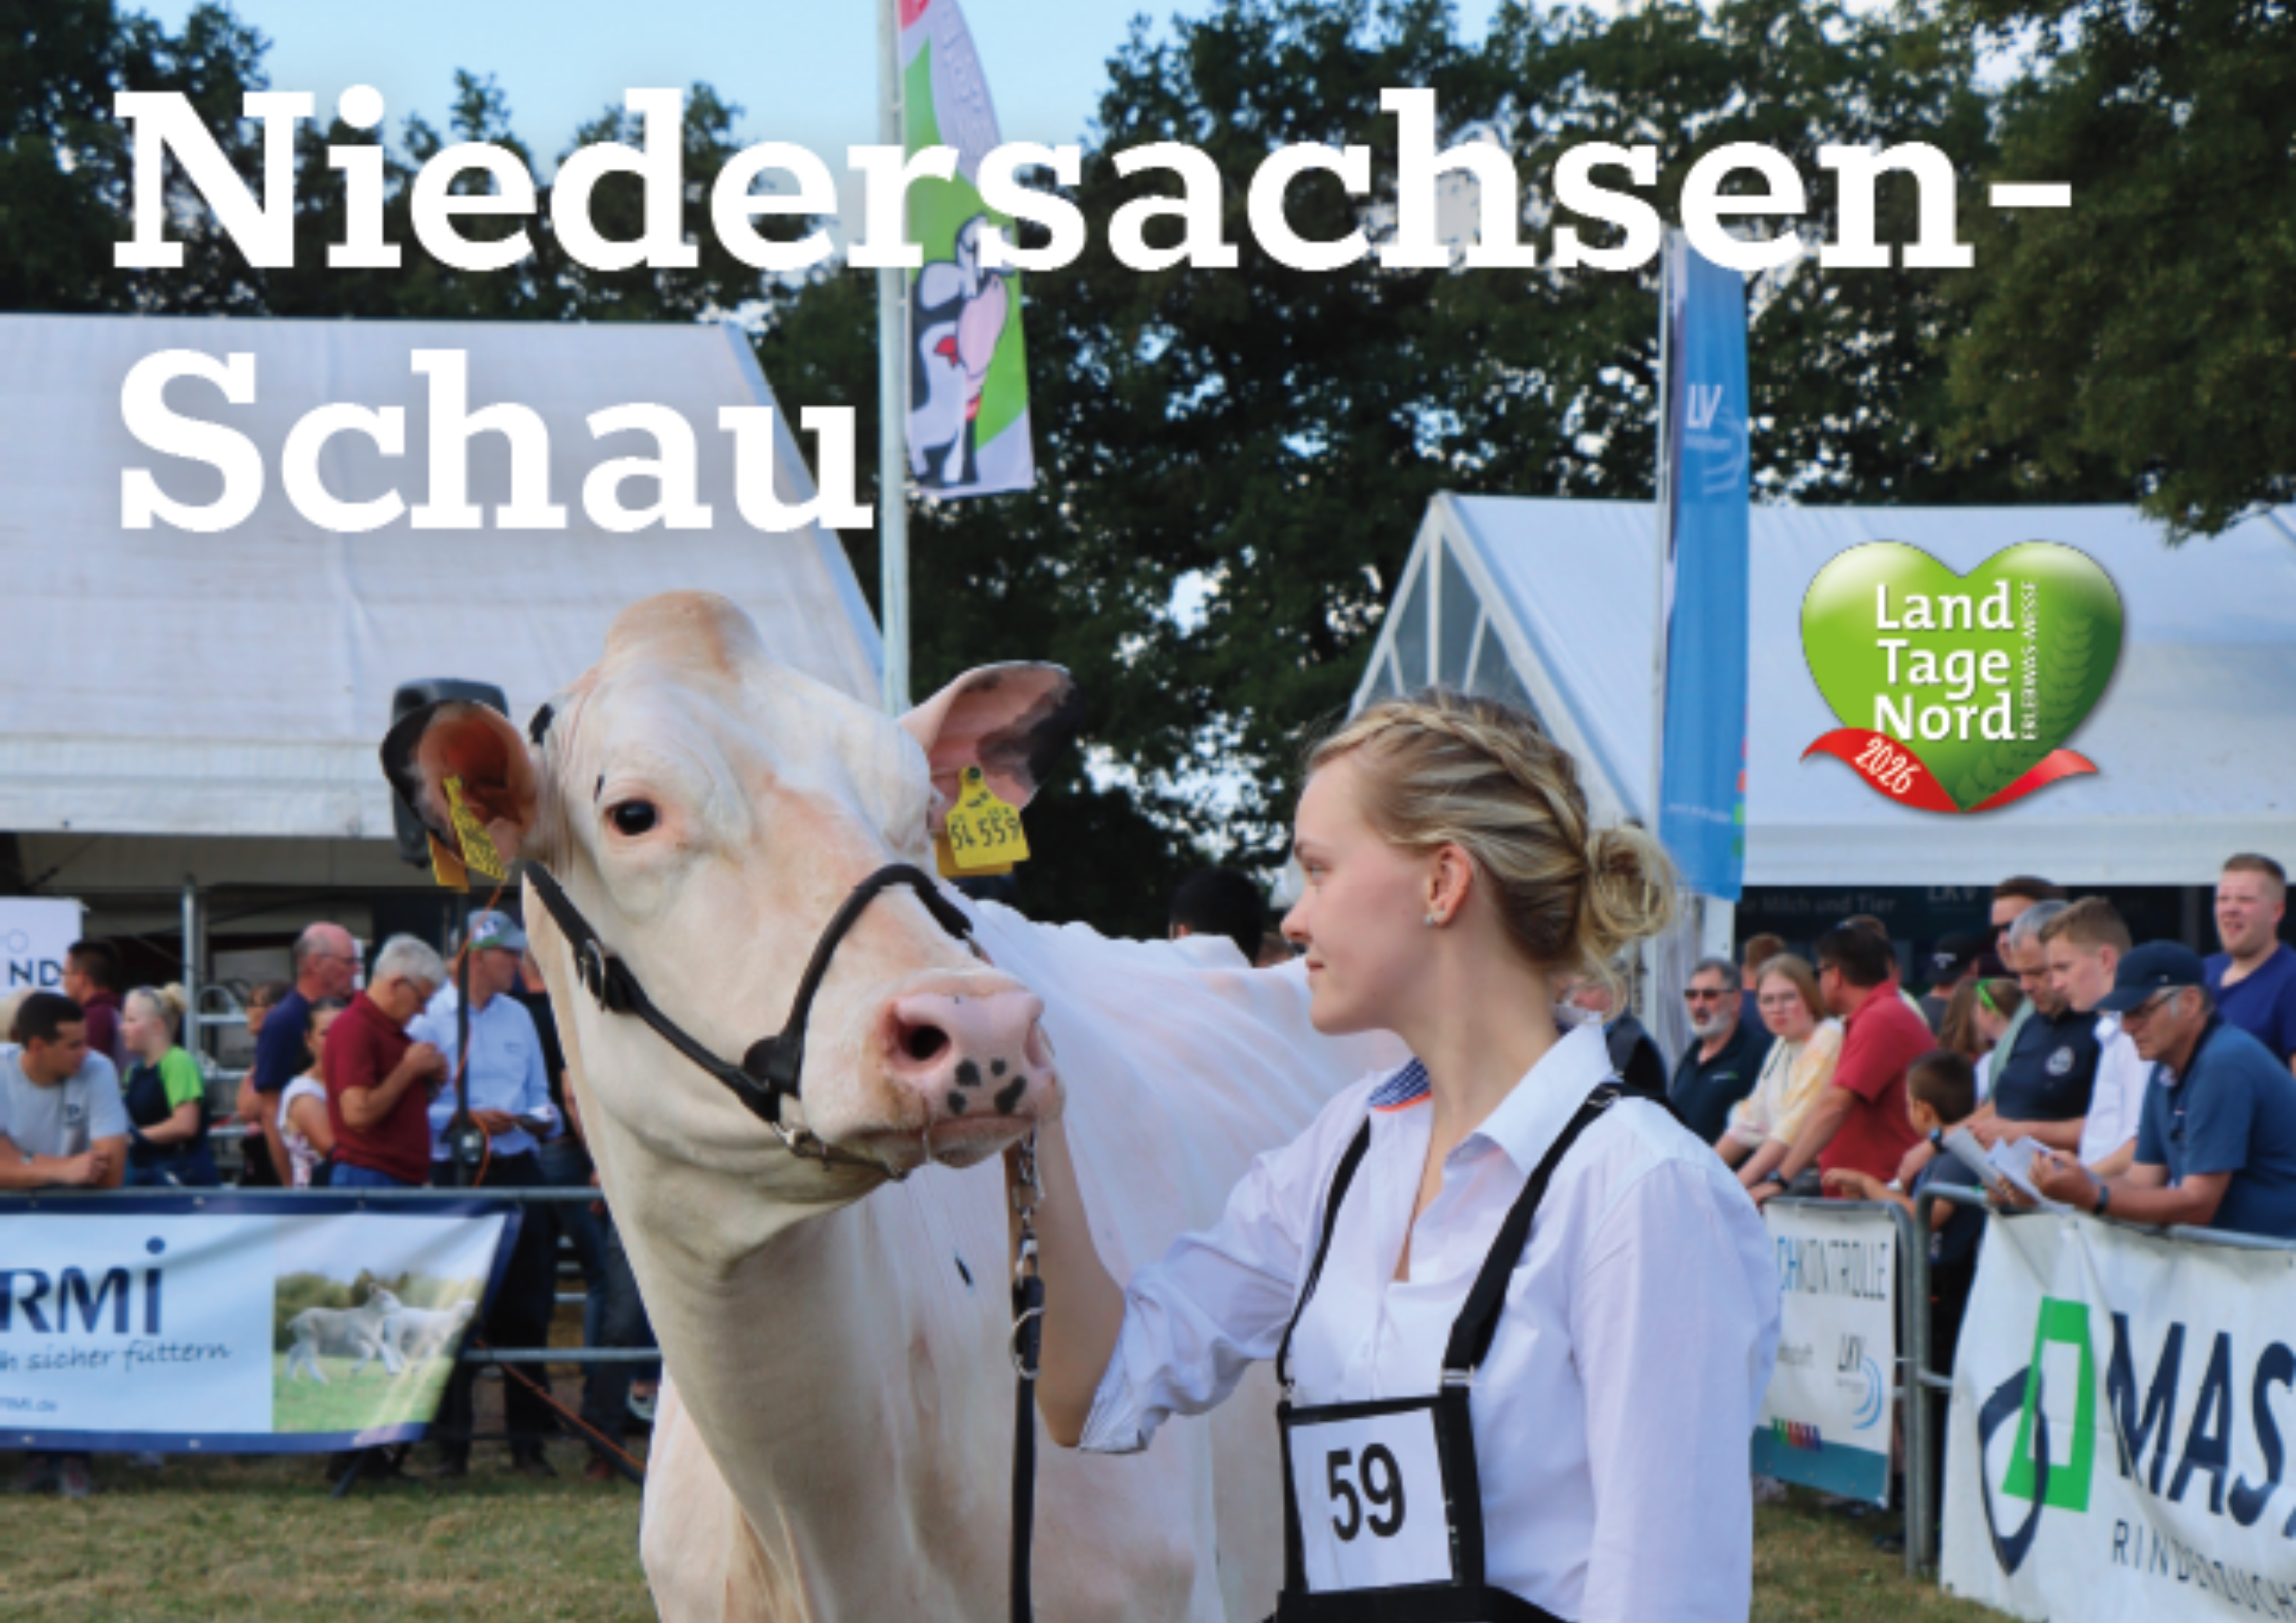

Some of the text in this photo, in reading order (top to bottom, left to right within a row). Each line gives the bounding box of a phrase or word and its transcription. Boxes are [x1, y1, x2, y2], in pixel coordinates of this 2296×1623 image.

[27, 1344, 116, 1370] sicher
[123, 1340, 231, 1373] füttern
[2106, 1311, 2296, 1539] MAS
[1327, 1442, 1406, 1543] 59
